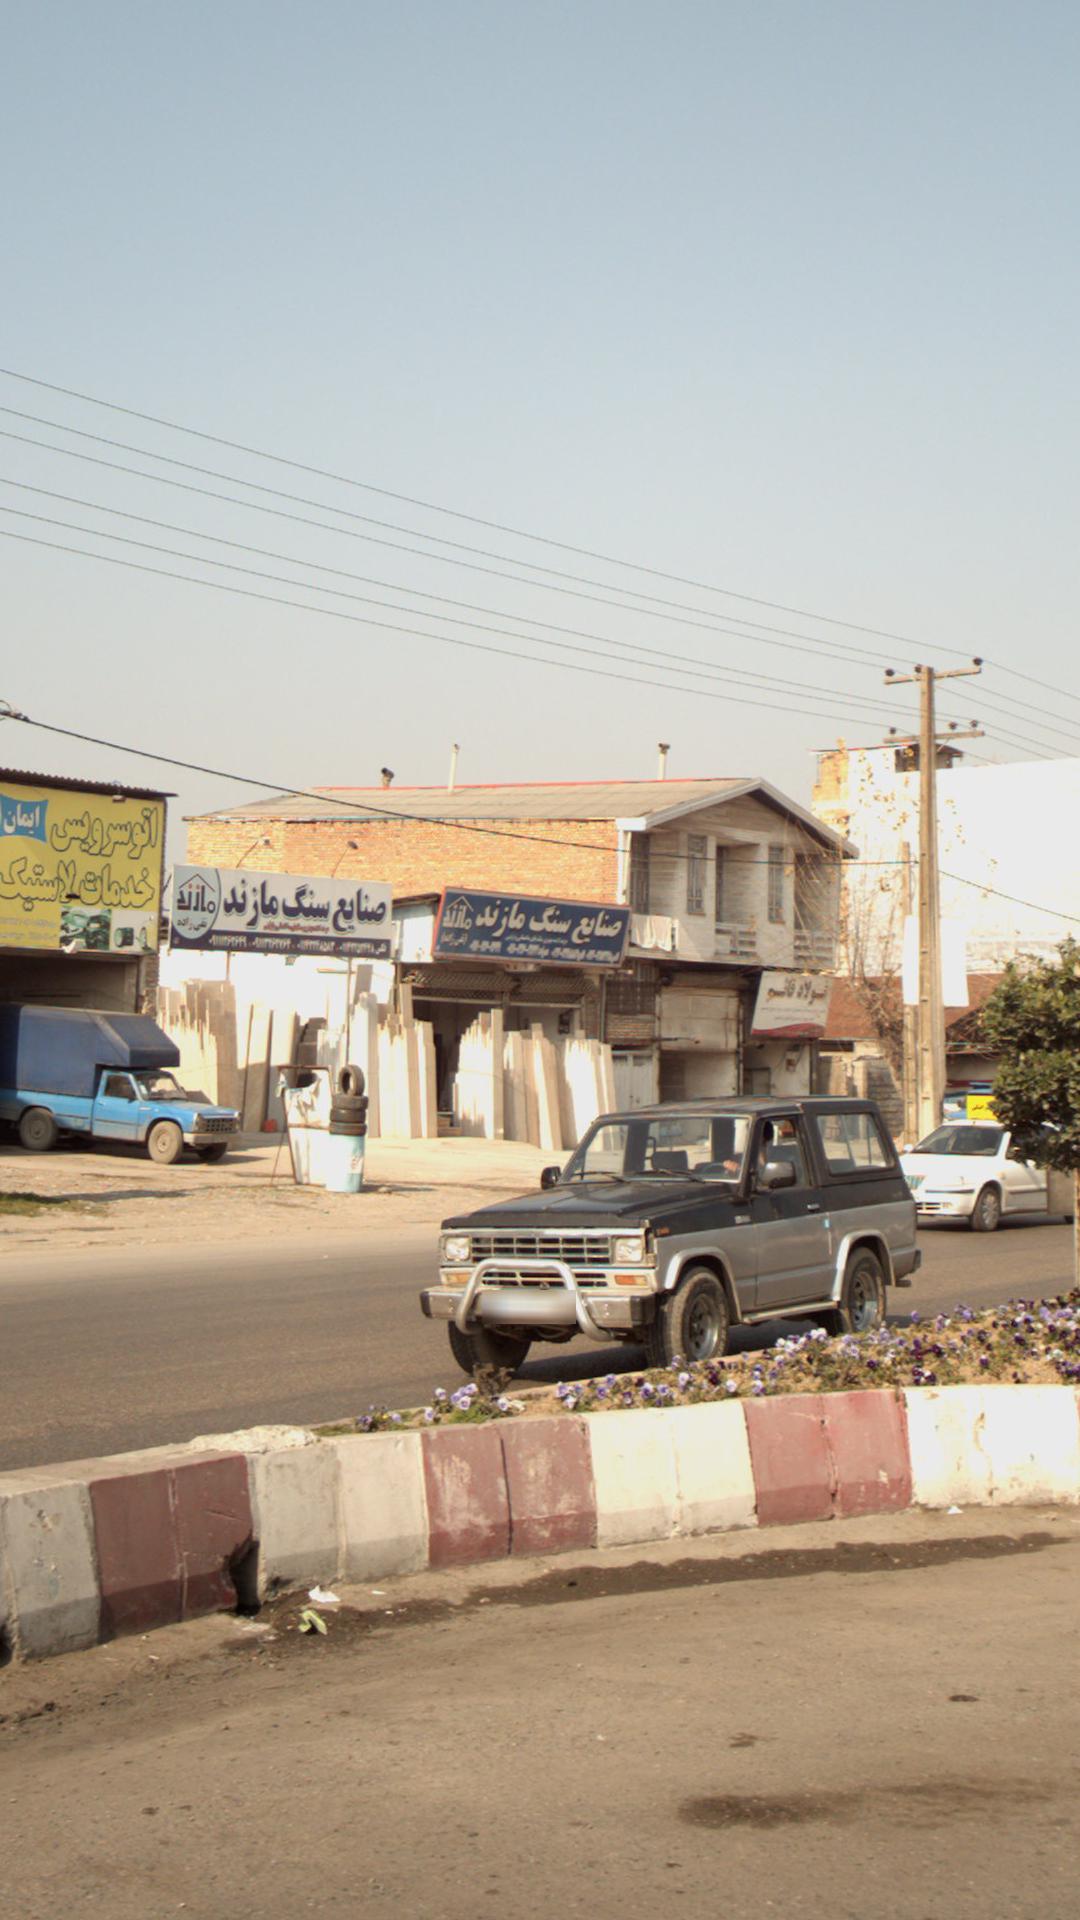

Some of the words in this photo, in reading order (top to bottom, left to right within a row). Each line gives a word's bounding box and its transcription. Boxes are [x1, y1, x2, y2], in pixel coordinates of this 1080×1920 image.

[3, 803, 40, 834] ایمان
[79, 866, 156, 909] خدمات
[223, 878, 280, 928] مازند
[282, 883, 330, 920] سنگ
[332, 888, 387, 933] صنایع
[475, 899, 526, 938] مازند
[529, 905, 572, 935] سنگ
[571, 909, 623, 944] صنایع
